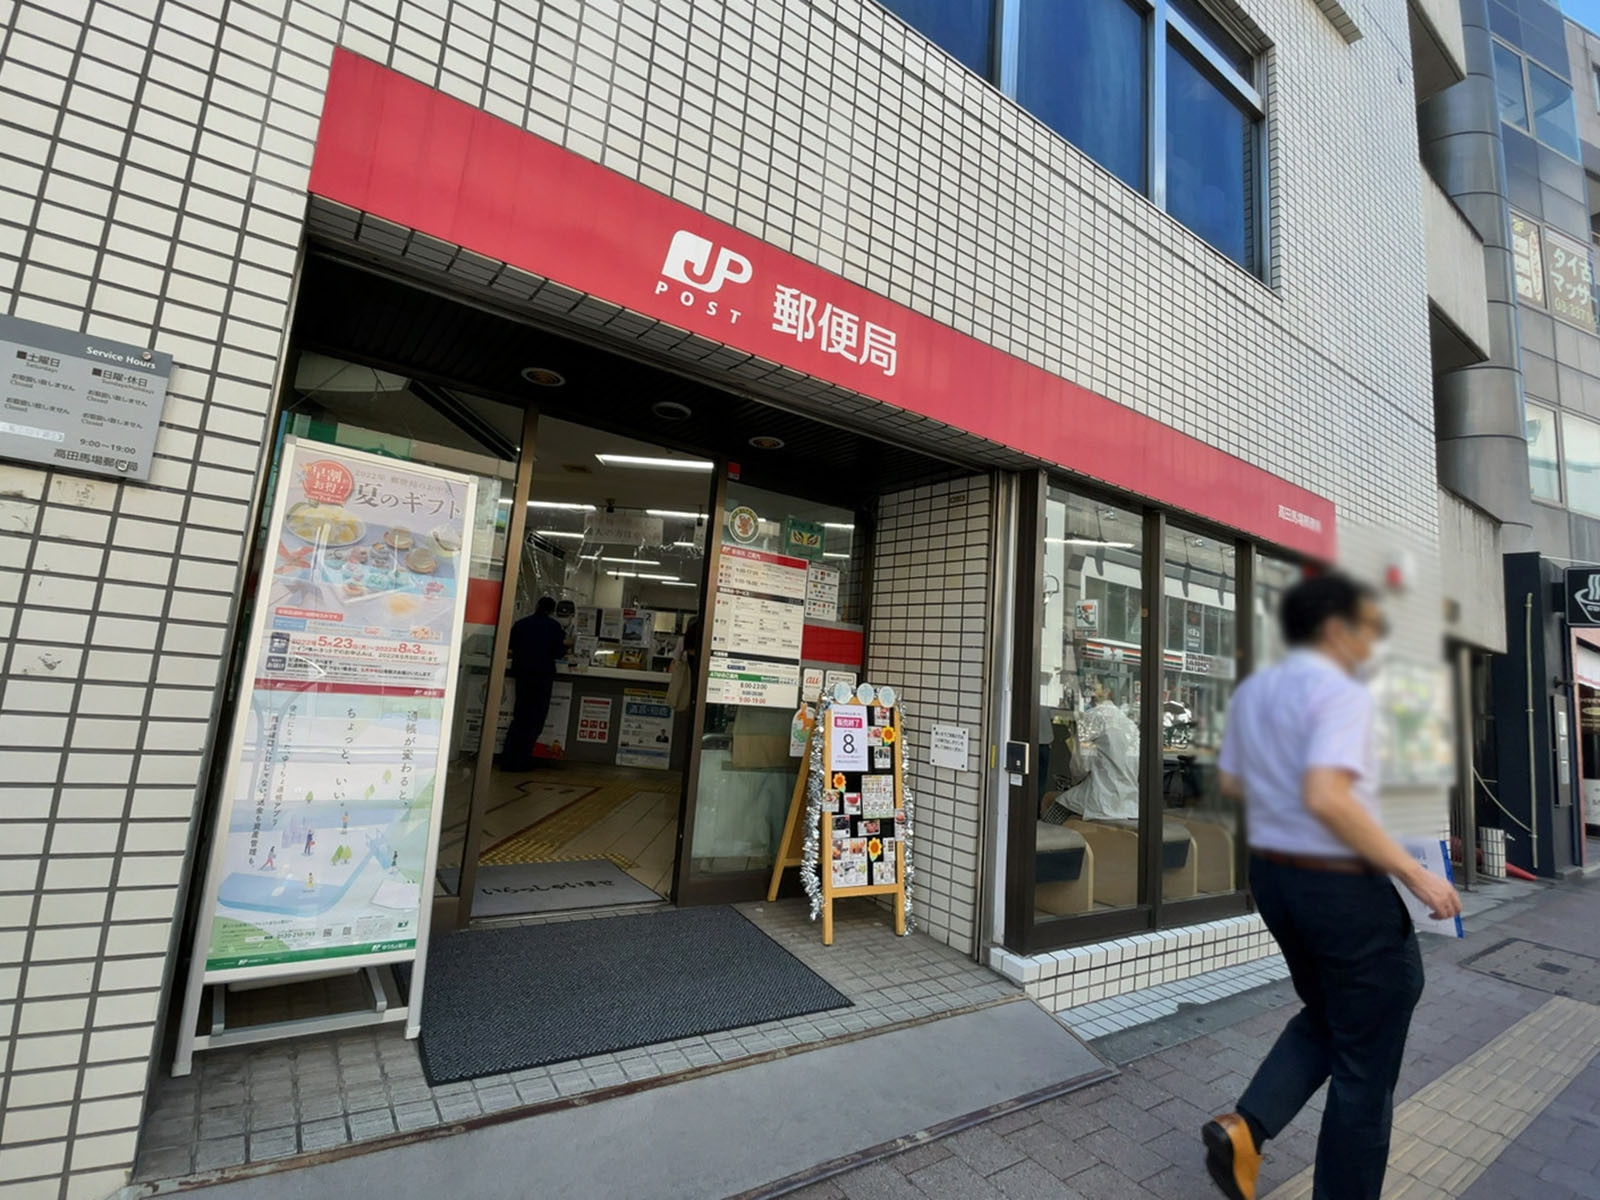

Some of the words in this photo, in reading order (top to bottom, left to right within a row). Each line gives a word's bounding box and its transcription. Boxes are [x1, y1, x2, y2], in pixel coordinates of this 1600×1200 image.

[655, 281, 741, 325] POST
[772, 284, 897, 377] 郵便局
[86, 346, 124, 362] Service
[126, 355, 156, 369] Hours
[355, 482, 462, 520] 夏のギフト
[843, 733, 856, 754] 8
